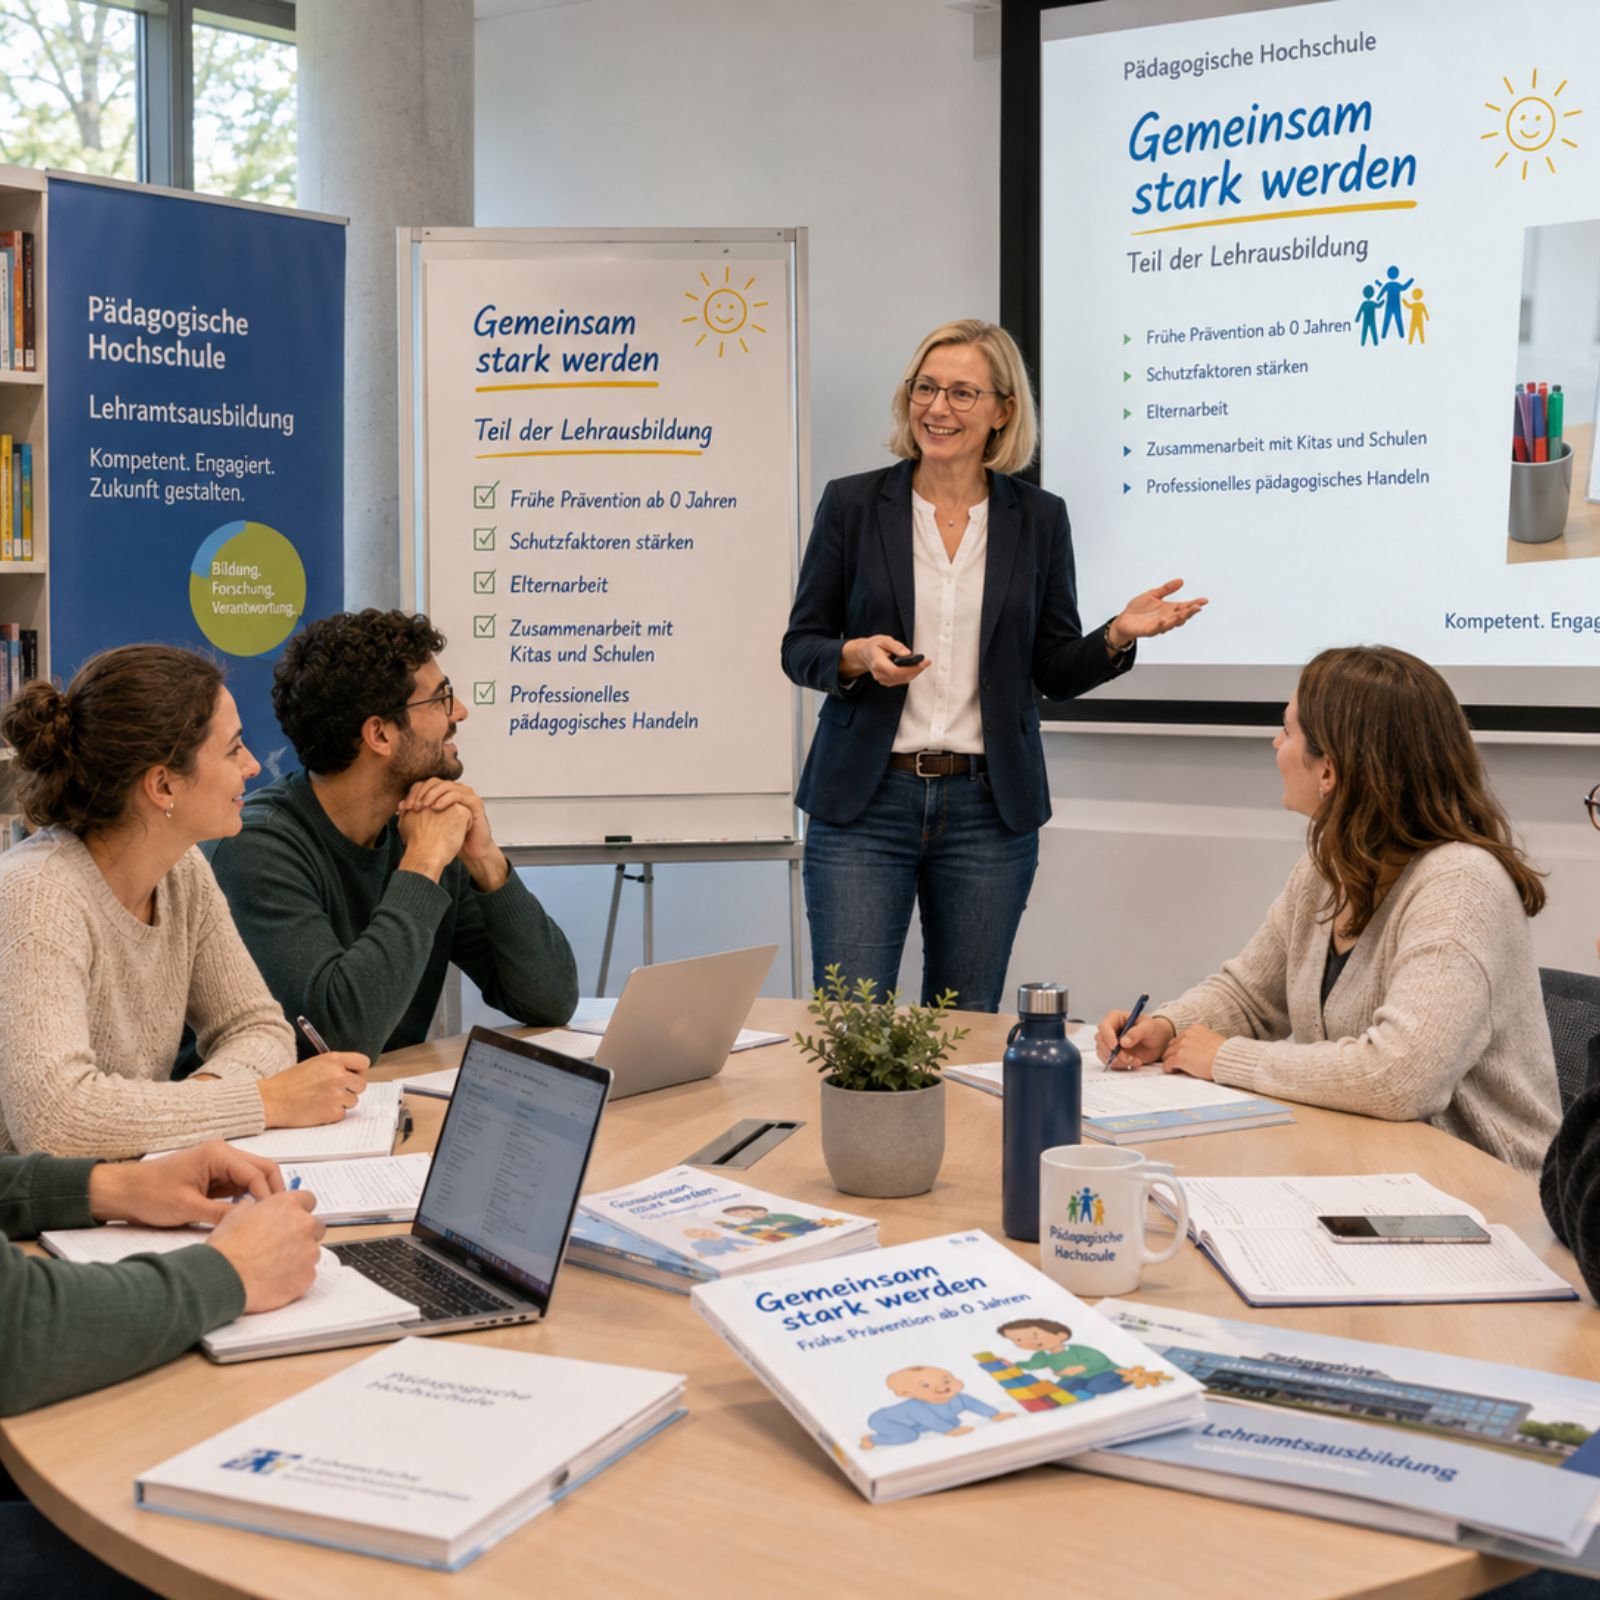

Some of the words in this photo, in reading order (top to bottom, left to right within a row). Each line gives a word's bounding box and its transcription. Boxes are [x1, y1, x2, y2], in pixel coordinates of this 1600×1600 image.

[1124, 47, 1254, 80] Pädagogische
[1260, 31, 1377, 64] Hochschule
[1128, 100, 1373, 164] Gemeinsam
[1131, 157, 1242, 215] stark
[1261, 145, 1418, 196] werden
[1126, 248, 1162, 274] Teil
[1169, 246, 1203, 271] der
[1210, 234, 1369, 268] Lehrausbildung
[88, 295, 249, 338] Pädagogische
[473, 304, 636, 339] Gemeinsam
[1146, 326, 1186, 345] Frühe
[1189, 322, 1265, 342] Prävention
[1268, 320, 1286, 337] ab
[1289, 319, 1300, 336] 0
[1302, 317, 1352, 336] Jahren
[88, 335, 226, 370] Hochschule
[475, 345, 551, 374] stark
[562, 342, 659, 373] werden
[1146, 362, 1252, 383] Schutzfaktoren
[1256, 358, 1309, 376] stärken
[89, 394, 294, 436] Lehramtsausbildung
[1146, 400, 1229, 420] Elternarbeit
[474, 417, 512, 442] Teil
[519, 417, 554, 442] der
[560, 418, 713, 449] Lehrausbildung
[1146, 437, 1265, 457] Zusammenarbeit
[1268, 435, 1293, 451] mit
[1296, 434, 1333, 450] Kitas
[1336, 431, 1365, 449] und
[1368, 429, 1428, 448] Schulen
[90, 447, 191, 475] Kompetent.
[195, 452, 275, 478] Engagiert.
[89, 476, 160, 500] Zukunft
[164, 480, 245, 505] gestalten.
[1146, 474, 1252, 494] Professionelles
[1255, 471, 1363, 495] pädagogisches
[1366, 468, 1430, 486] Handeln
[510, 490, 555, 509] Frühe
[560, 489, 641, 509] Prävention
[646, 490, 665, 509] ab
[669, 490, 682, 509] 0
[685, 490, 737, 509] Jahren
[509, 531, 631, 553] Schutzfaktoren
[635, 532, 694, 551] stärken
[211, 560, 262, 579] Bildung.
[510, 574, 609, 594] Elternarbeit
[211, 581, 275, 599] Forschung.
[509, 618, 642, 638] Zusammenarbeit
[647, 619, 674, 637] mit
[1445, 611, 1545, 634] Kompetent.
[510, 644, 552, 663] Kitas
[557, 644, 588, 663] und
[592, 644, 655, 663] Schulen
[509, 684, 630, 705] Professionelles
[509, 711, 627, 736] pädagogisches
[632, 711, 699, 730] Handeln
[755, 1264, 940, 1314] Gemeinsam
[781, 1299, 869, 1332] stark
[875, 1275, 988, 1310] werden
[796, 1333, 845, 1352] Frühe
[847, 1313, 935, 1340] Prävention
[939, 1307, 959, 1321] ab
[977, 1292, 1032, 1313] Jahren
[1201, 1422, 1460, 1483] Lehramtsausbildung
